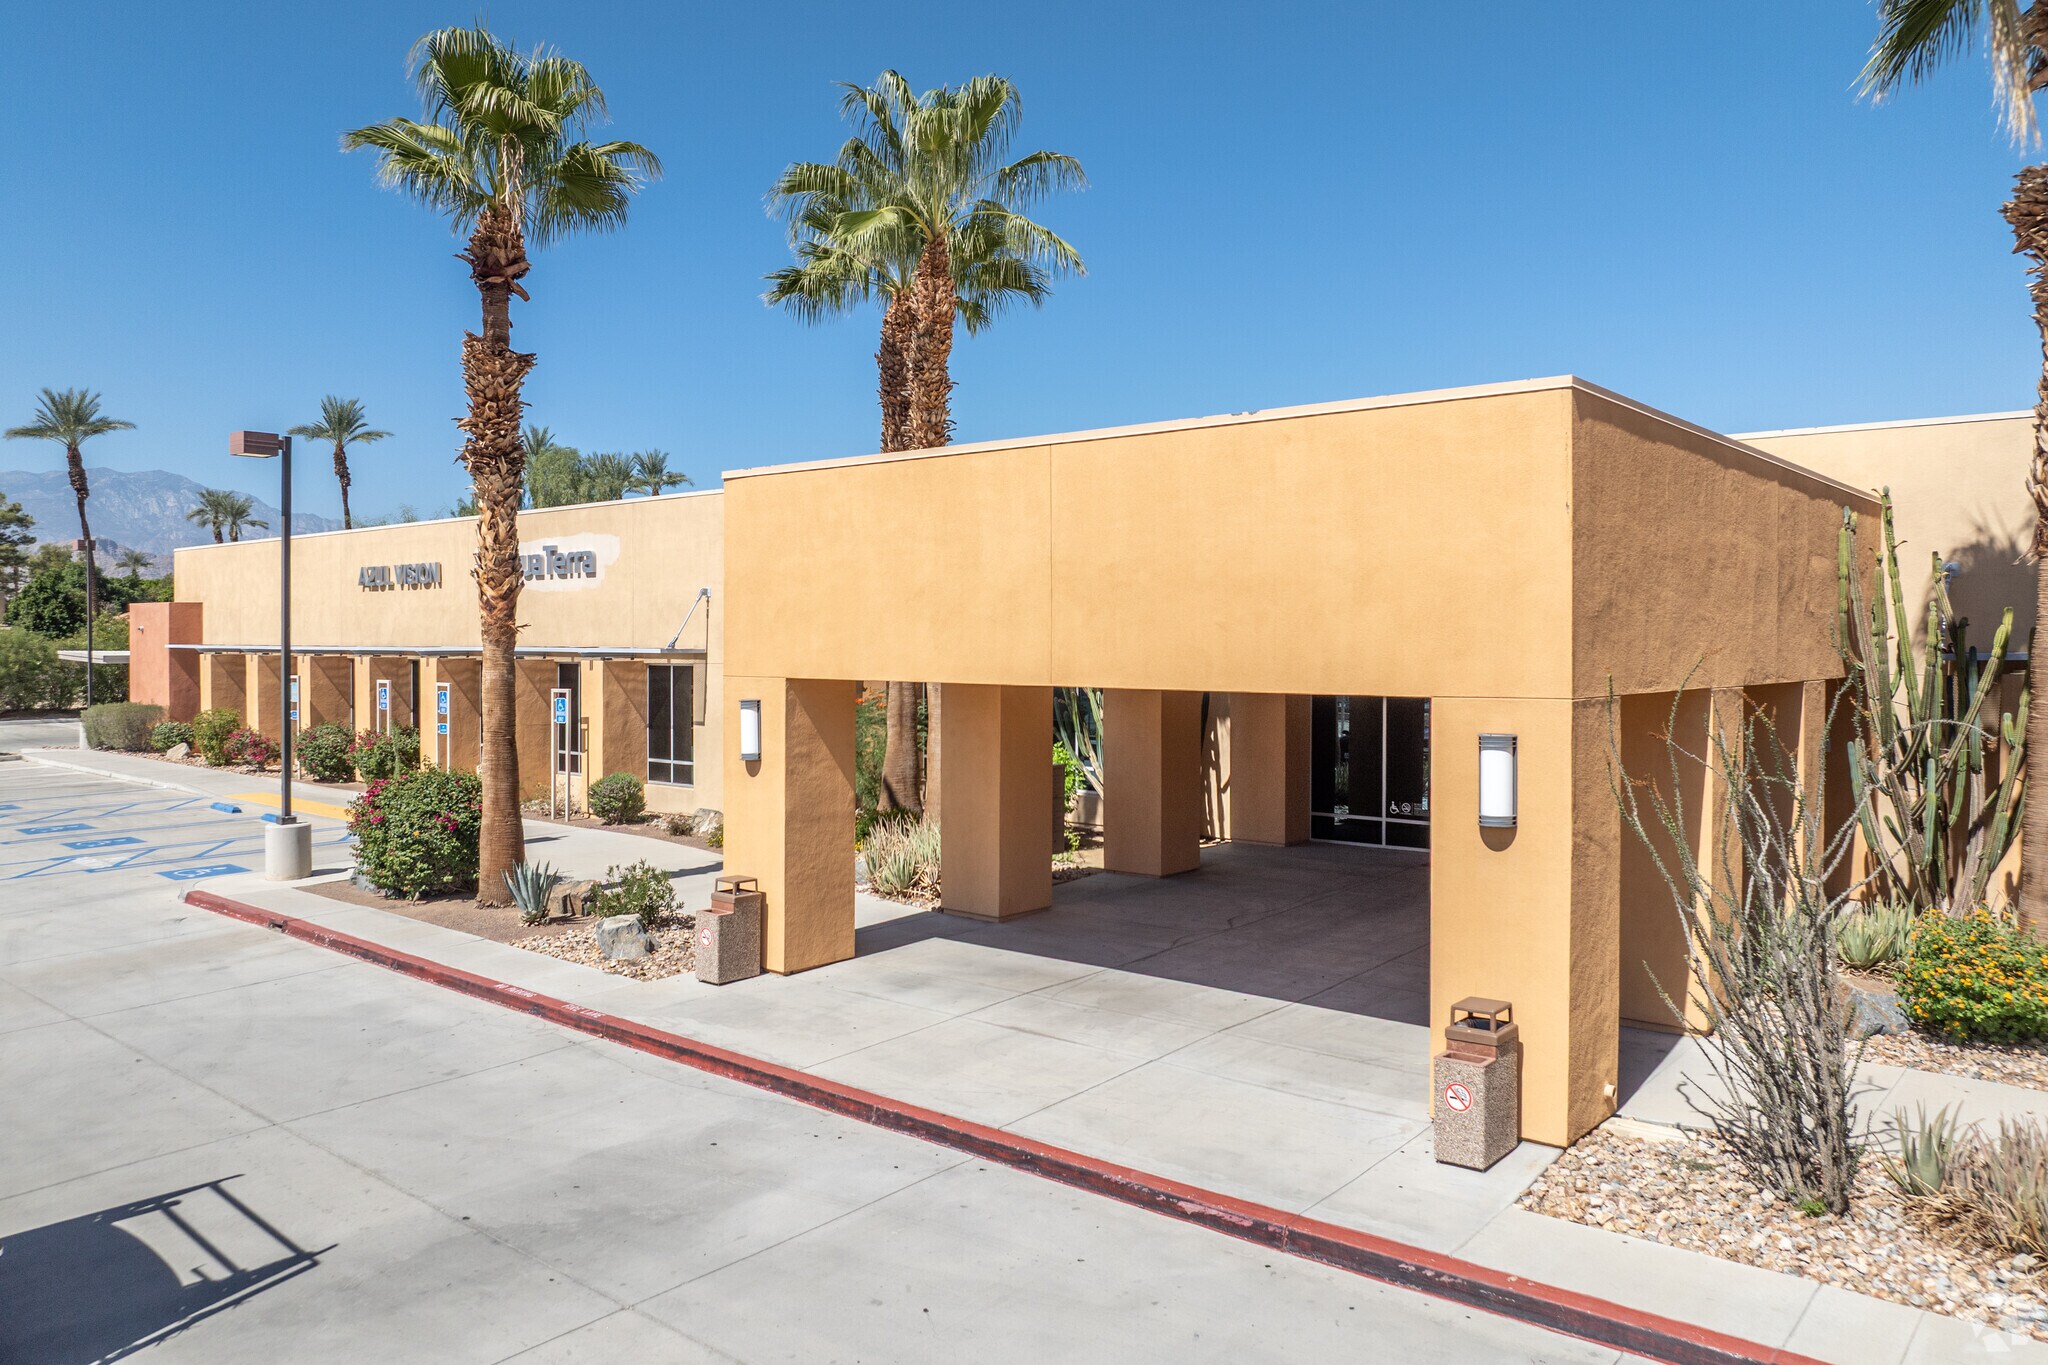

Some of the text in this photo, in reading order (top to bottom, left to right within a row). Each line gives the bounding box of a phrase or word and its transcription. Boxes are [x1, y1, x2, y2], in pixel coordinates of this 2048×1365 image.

[358, 562, 441, 586] AZUL VISION
[519, 545, 595, 577] uaTerra
